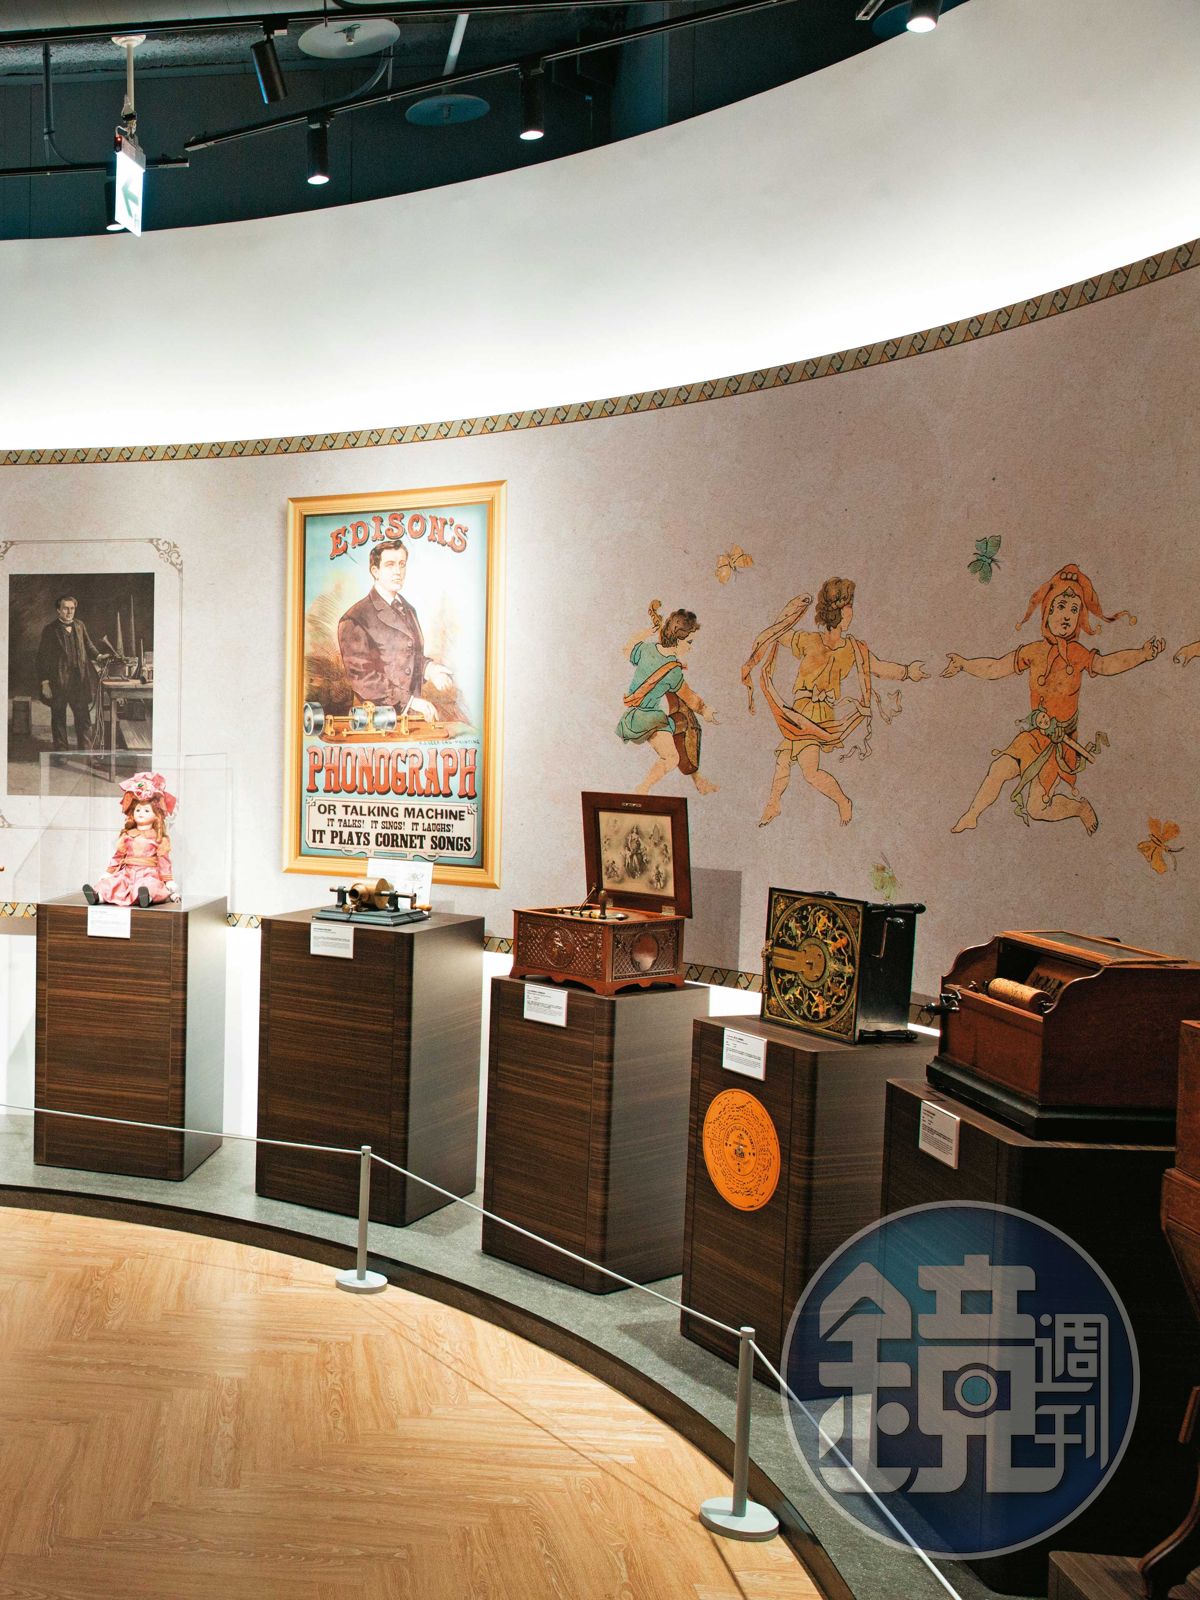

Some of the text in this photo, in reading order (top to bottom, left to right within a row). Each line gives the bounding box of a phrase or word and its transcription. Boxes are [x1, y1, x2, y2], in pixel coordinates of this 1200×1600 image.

[329, 512, 469, 560] EDISON'S
[307, 746, 477, 799] PHONOGRAPH
[317, 803, 466, 821] OR TALKING MACHINE
[326, 818, 454, 833] IT TALKS! IT SINGS! IT LAUGHS!
[311, 829, 472, 852] IT PLAYS CORNET SONGS
